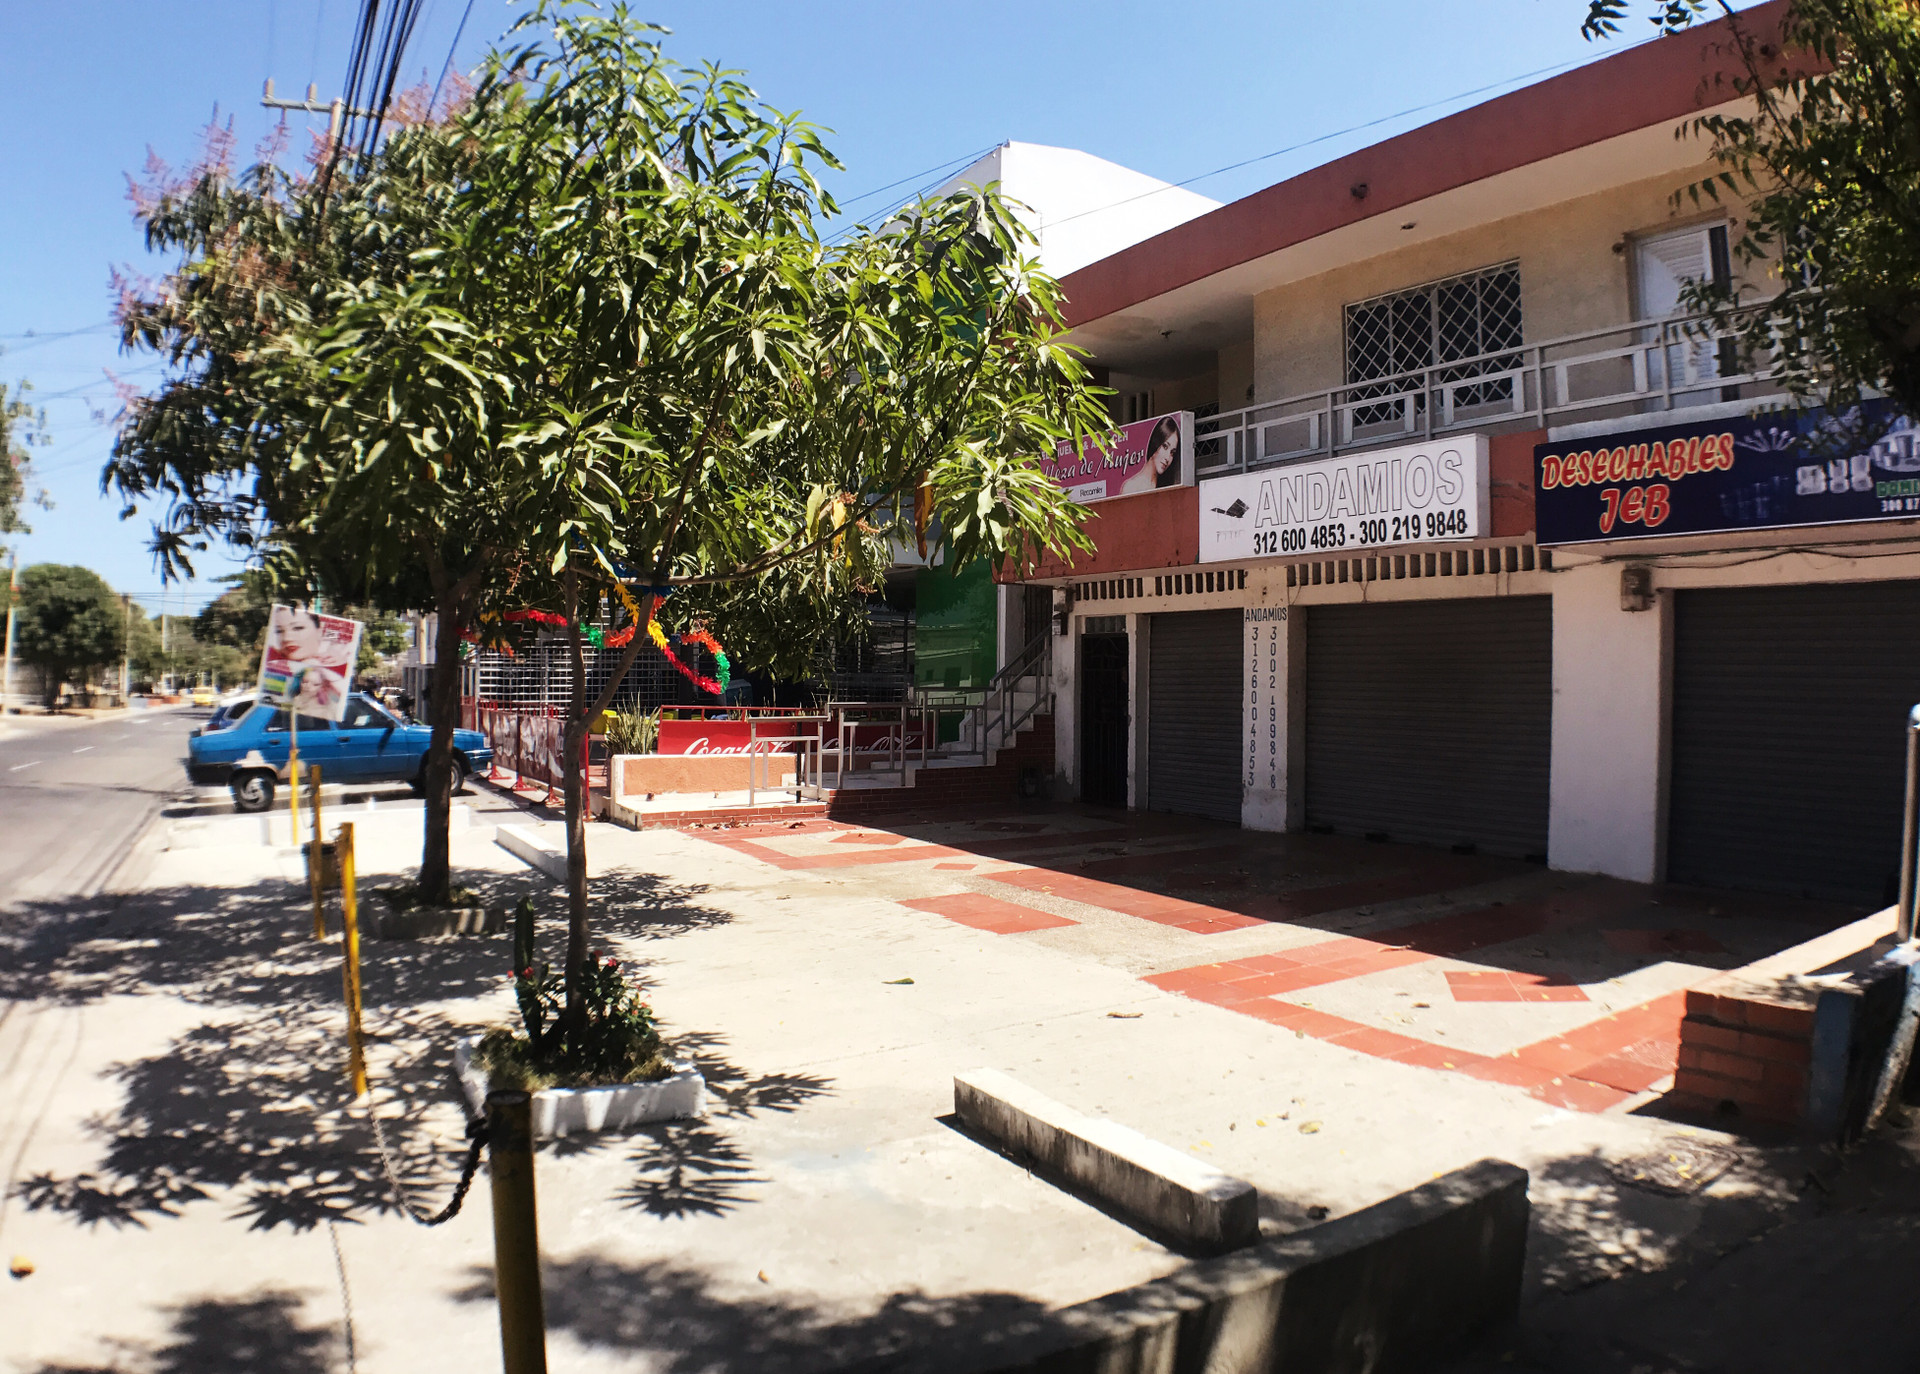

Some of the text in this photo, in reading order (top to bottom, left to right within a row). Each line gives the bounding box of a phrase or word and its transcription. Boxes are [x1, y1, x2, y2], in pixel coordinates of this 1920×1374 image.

[1080, 456, 1094, 475] de
[1094, 448, 1145, 477] Mujer
[1541, 432, 1735, 490] DESECHABLES
[1254, 450, 1464, 528] ANDAMIOS
[1600, 484, 1671, 534] JEB
[1253, 531, 1277, 555] 312
[1281, 528, 1306, 552] 600
[1310, 523, 1346, 549] 4853
[1359, 518, 1387, 545] 300
[1392, 514, 1421, 541] 219
[1426, 508, 1467, 537] 9848
